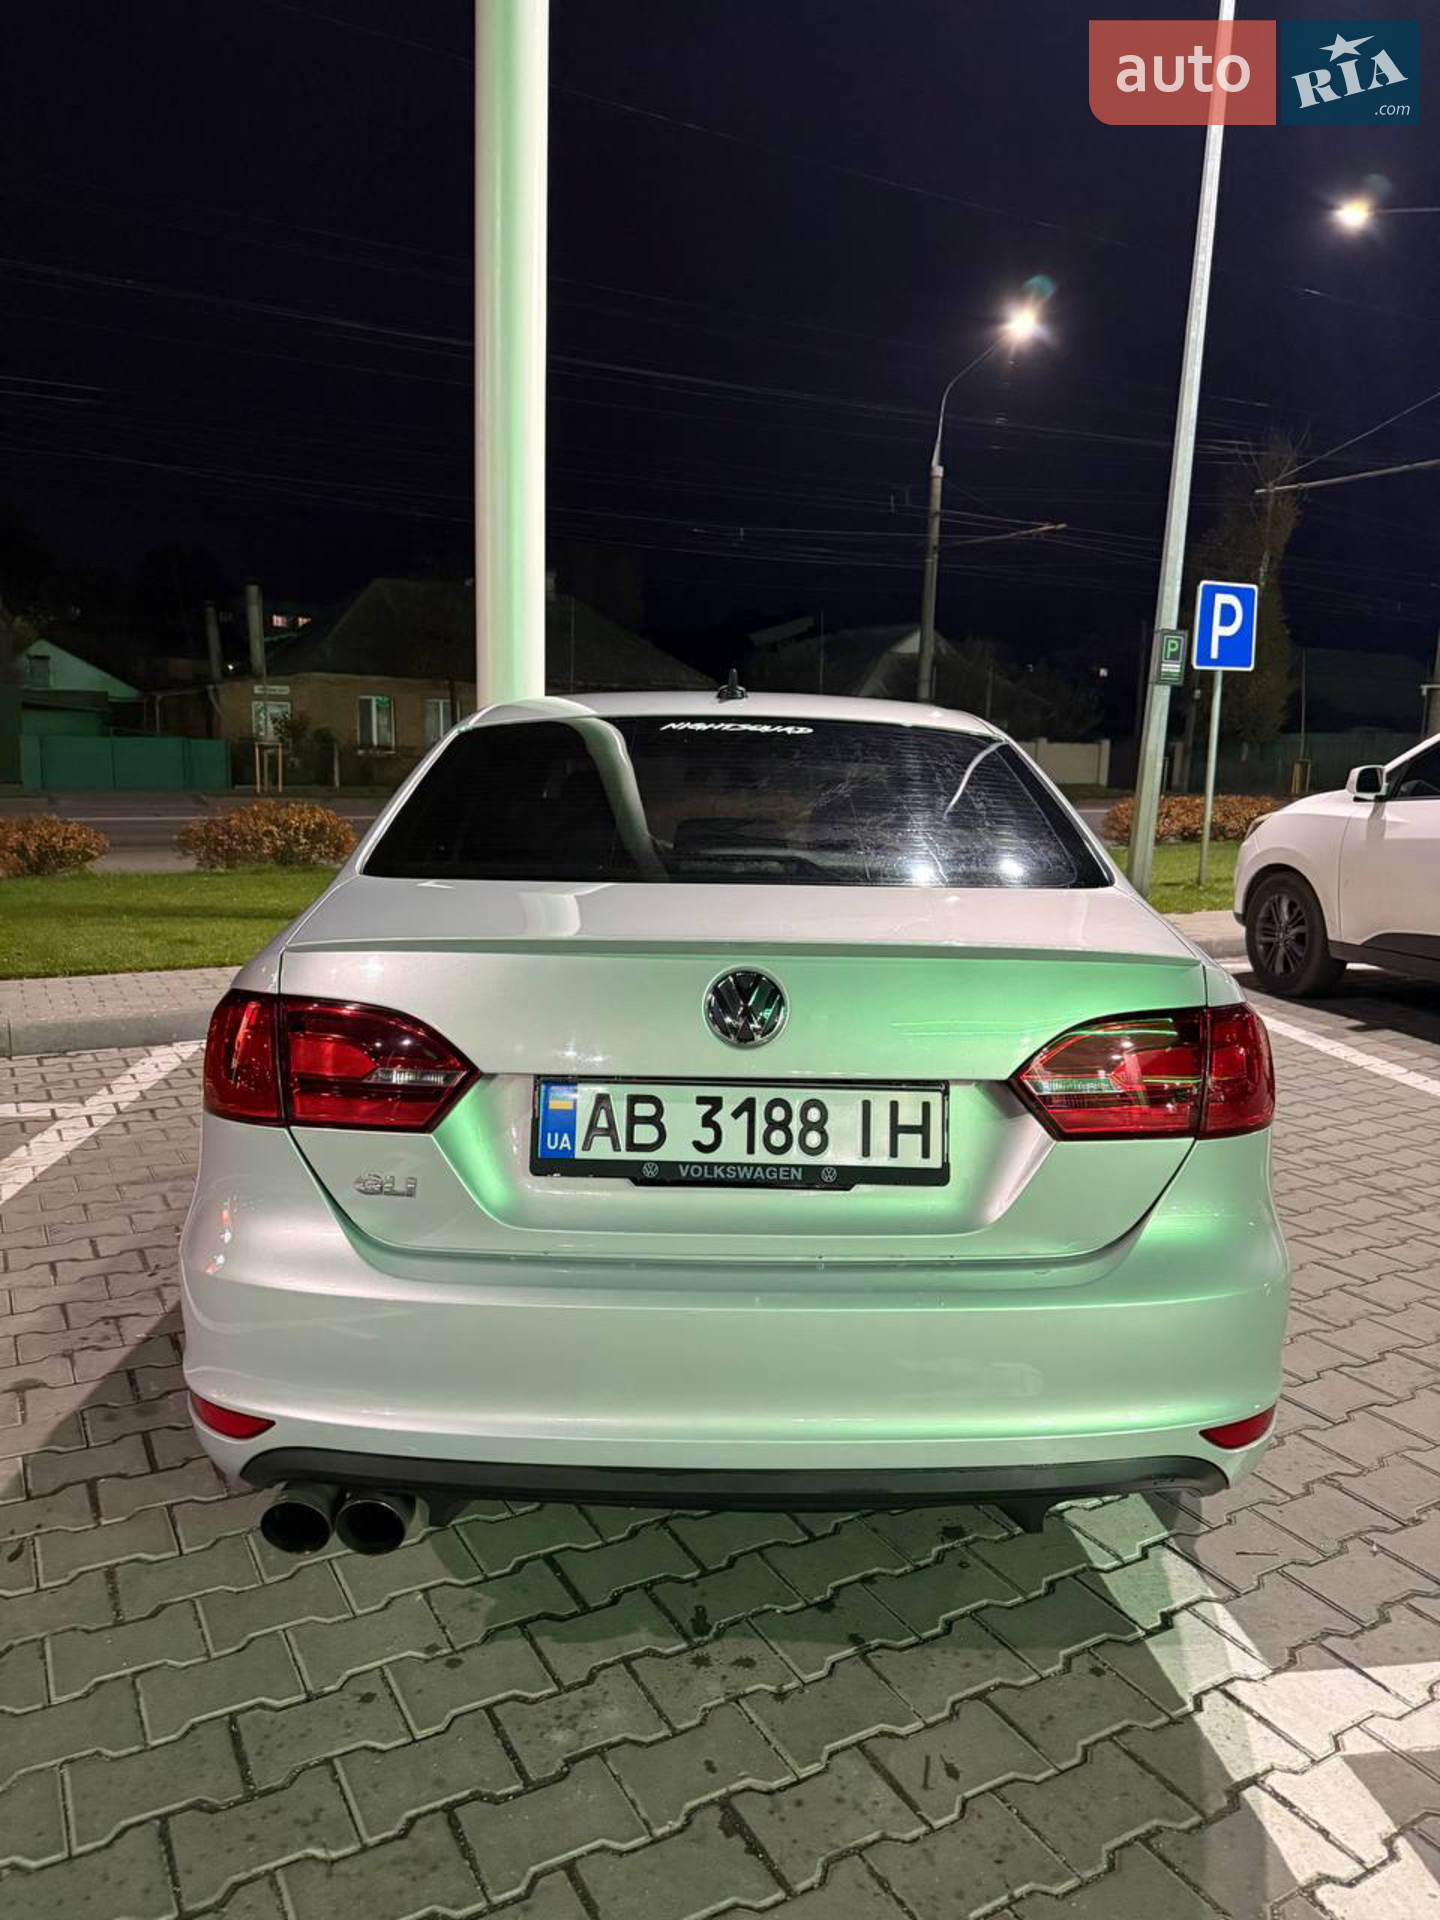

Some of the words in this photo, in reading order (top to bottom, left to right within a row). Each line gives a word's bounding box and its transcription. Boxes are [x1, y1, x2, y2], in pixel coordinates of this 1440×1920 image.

[1210, 593, 1243, 659] P
[1166, 639, 1180, 660] P
[581, 1093, 667, 1152] AB
[691, 1096, 829, 1156] 3188
[861, 1099, 931, 1158] IH
[546, 1132, 572, 1151] UA
[678, 1163, 803, 1181] VOLKSWAGEN
